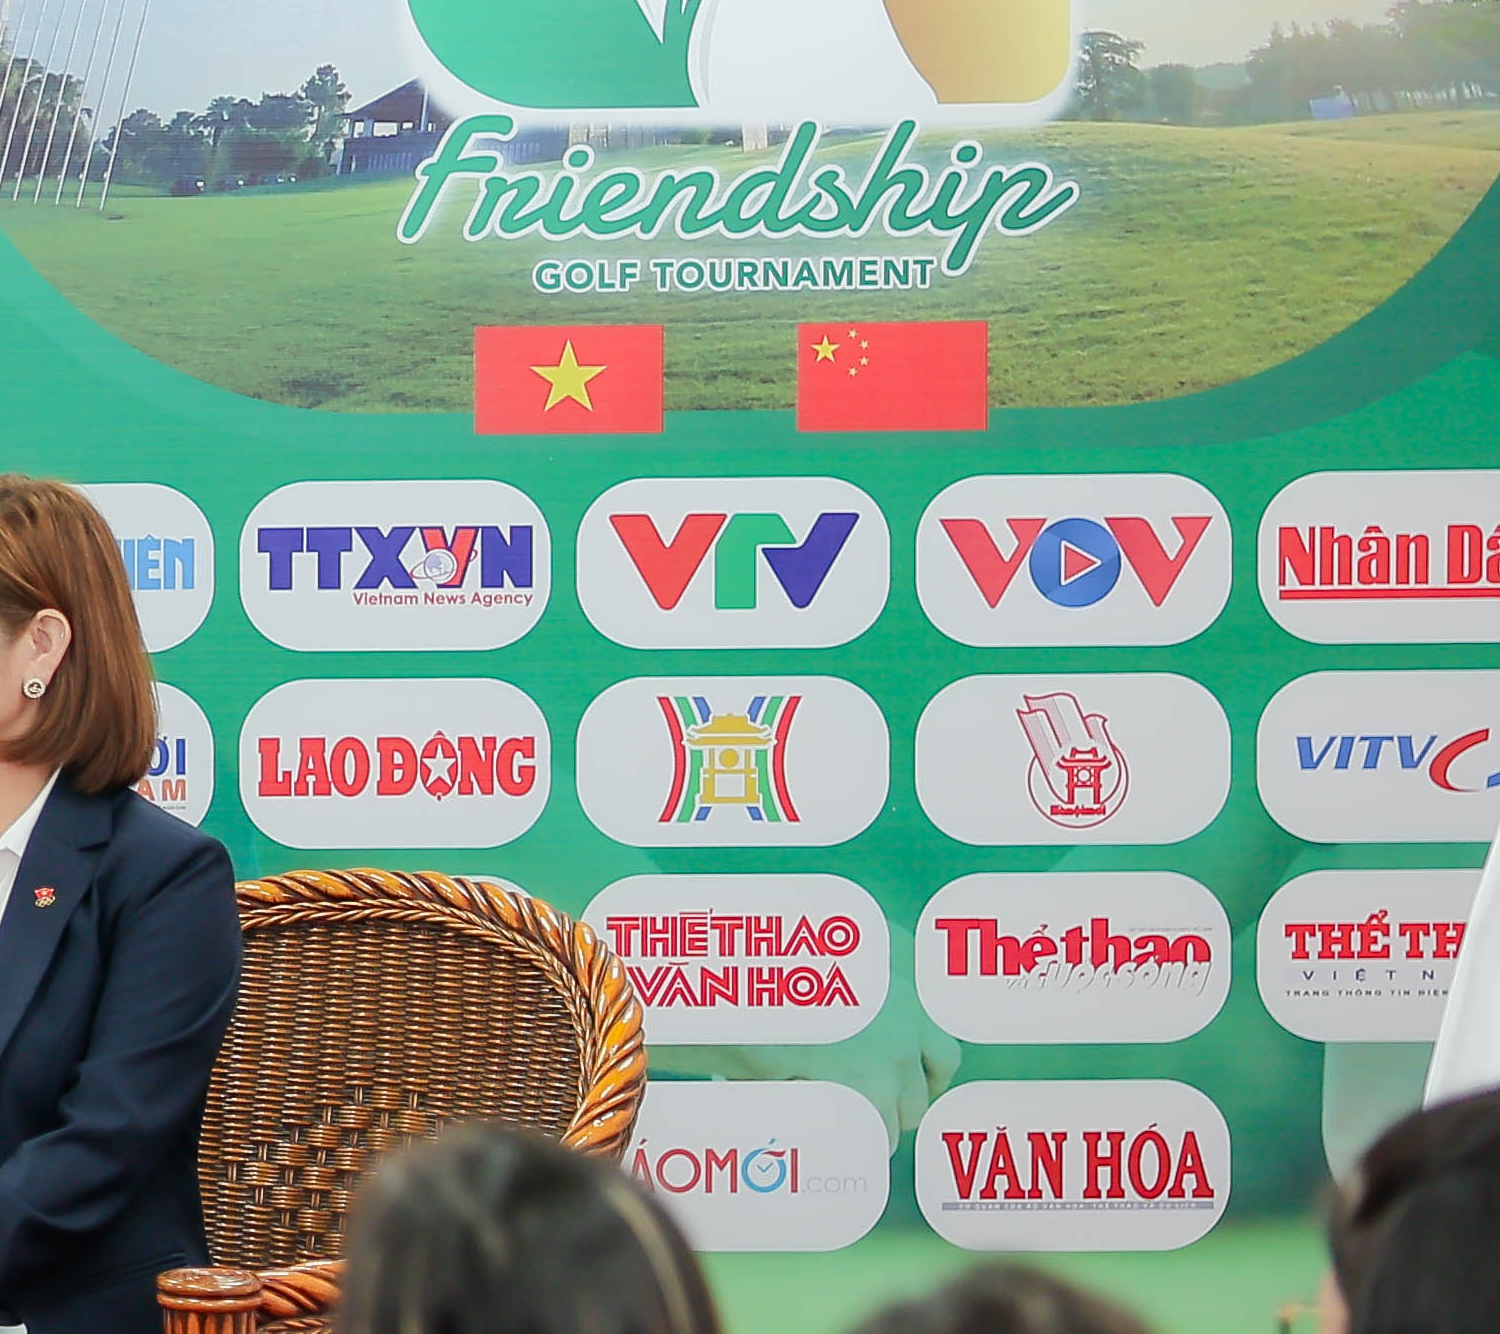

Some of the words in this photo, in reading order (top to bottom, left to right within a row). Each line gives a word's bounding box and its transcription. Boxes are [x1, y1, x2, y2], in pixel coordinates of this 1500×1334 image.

[401, 114, 1074, 272] Friendship
[536, 262, 638, 290] GOLF
[656, 259, 936, 289] TOURNAMENT
[257, 525, 534, 592] TTXVN
[609, 512, 860, 611] VTV
[939, 516, 1213, 609] VOV
[1278, 525, 1430, 587] Nhân
[353, 591, 419, 607] Vietnam
[423, 591, 467, 606] News
[470, 590, 534, 608] Agency
[257, 737, 371, 798] LAO
[1296, 735, 1438, 770] VITV
[136, 780, 187, 801] AM
[709, 914, 861, 957] THAO
[1284, 908, 1391, 960] THỂ
[630, 1137, 867, 1195] ÁOMỚI.com
[940, 1126, 1068, 1201] VĂN
[1082, 1123, 1215, 1200] HÓA
